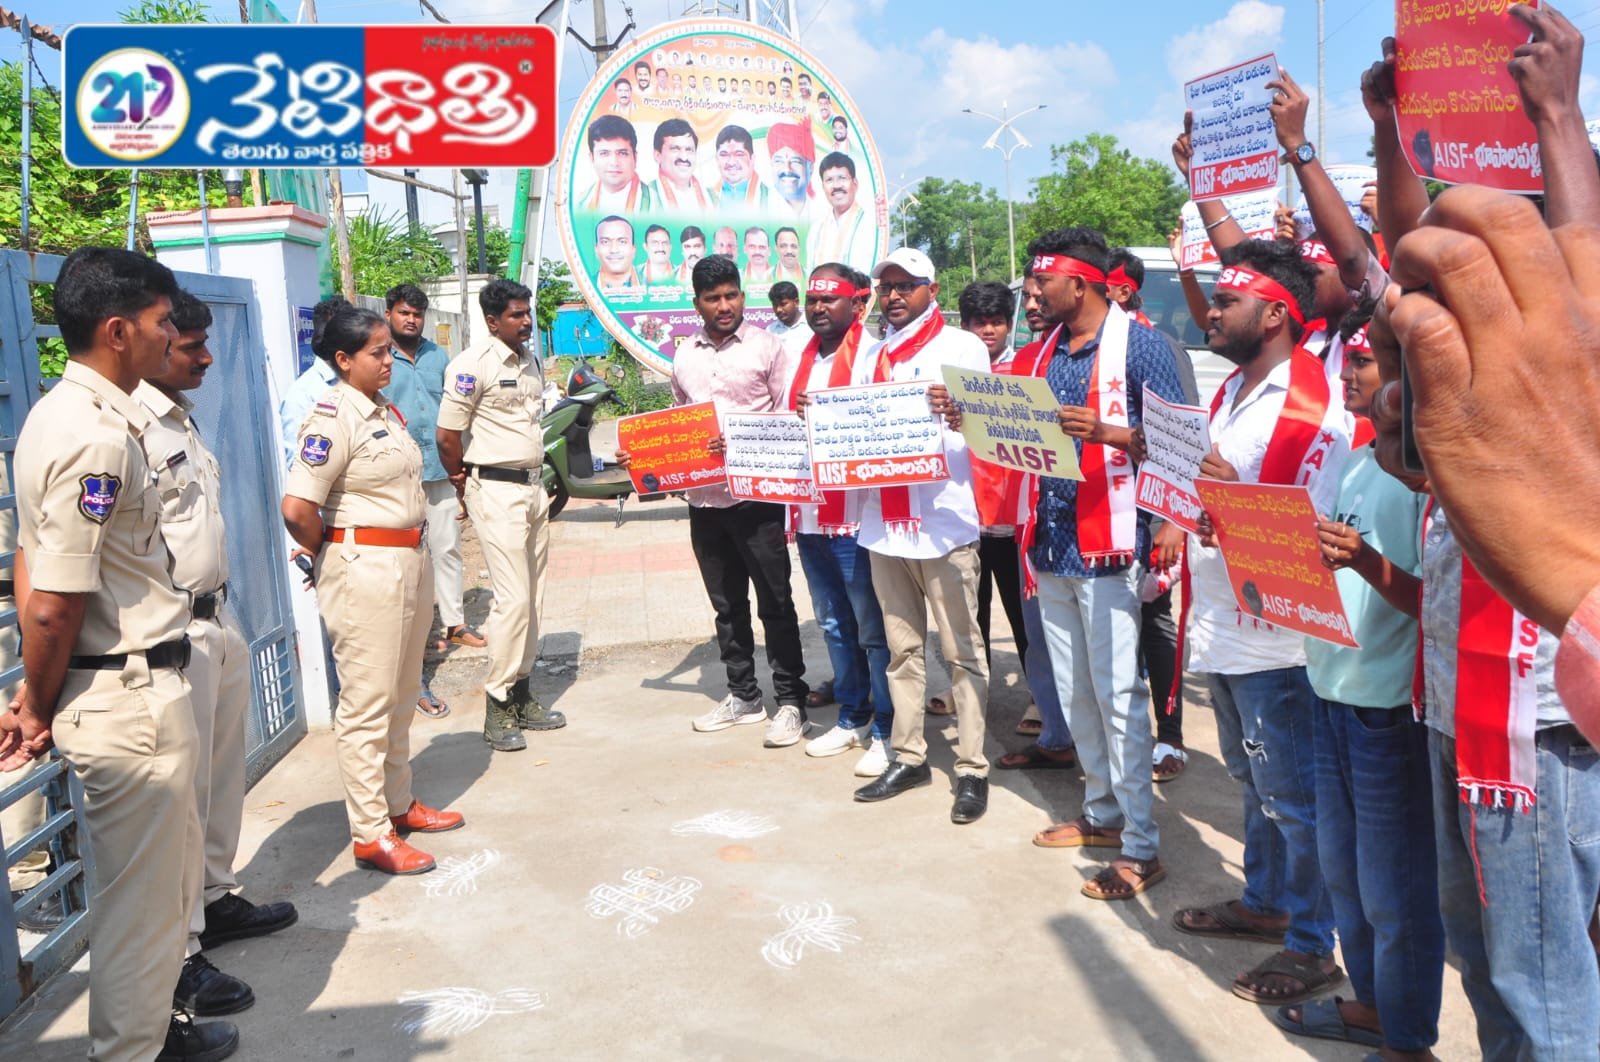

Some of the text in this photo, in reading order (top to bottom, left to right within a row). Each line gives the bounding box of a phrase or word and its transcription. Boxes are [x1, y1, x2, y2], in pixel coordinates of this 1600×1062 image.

[1195, 167, 1216, 194] AISF
[807, 279, 839, 291] ISF
[1220, 269, 1254, 287] SF
[890, 386, 925, 398] విడుదల
[818, 462, 847, 484] AISF
[732, 476, 753, 496] AISF
[1140, 475, 1165, 508] AISF
